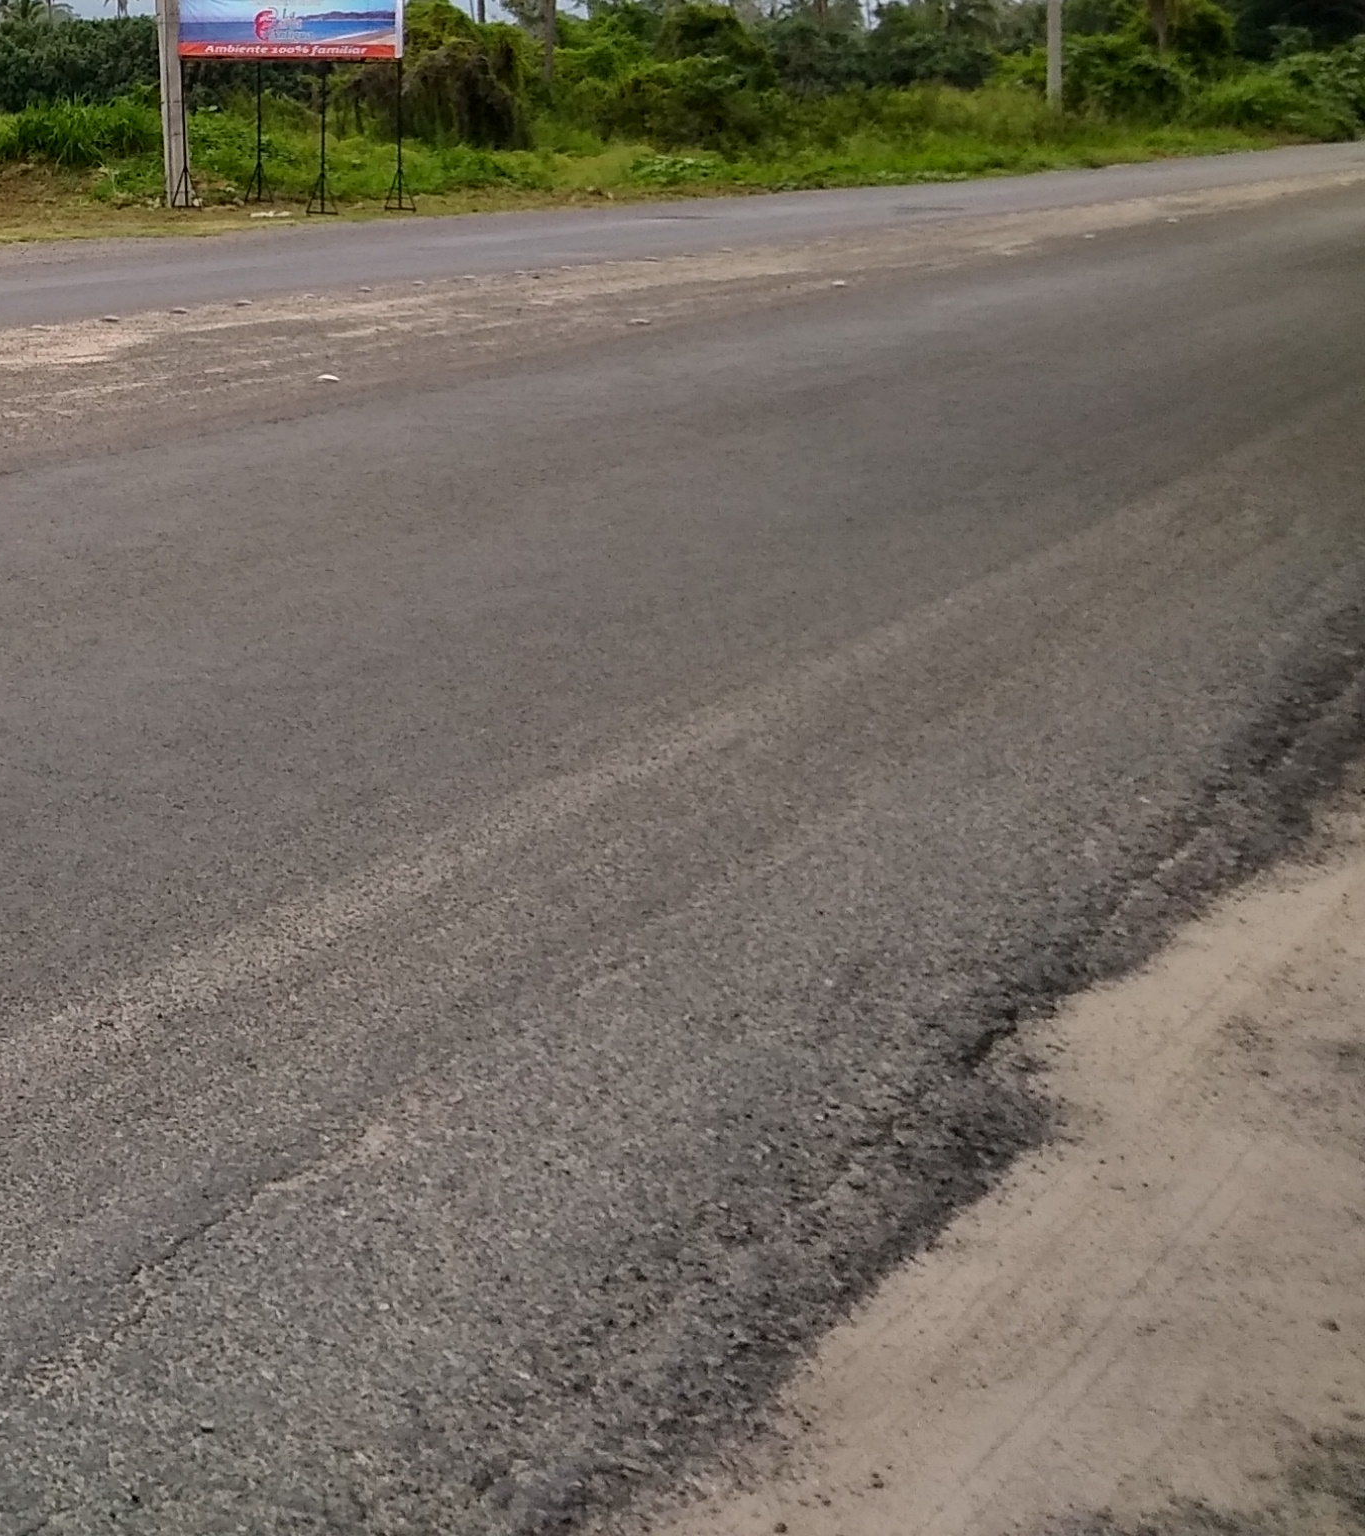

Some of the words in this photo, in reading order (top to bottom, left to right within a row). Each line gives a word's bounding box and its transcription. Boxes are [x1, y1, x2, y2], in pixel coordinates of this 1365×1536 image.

[204, 44, 268, 54] Ambiente
[270, 45, 309, 54] 100%
[309, 45, 368, 56] familiar
